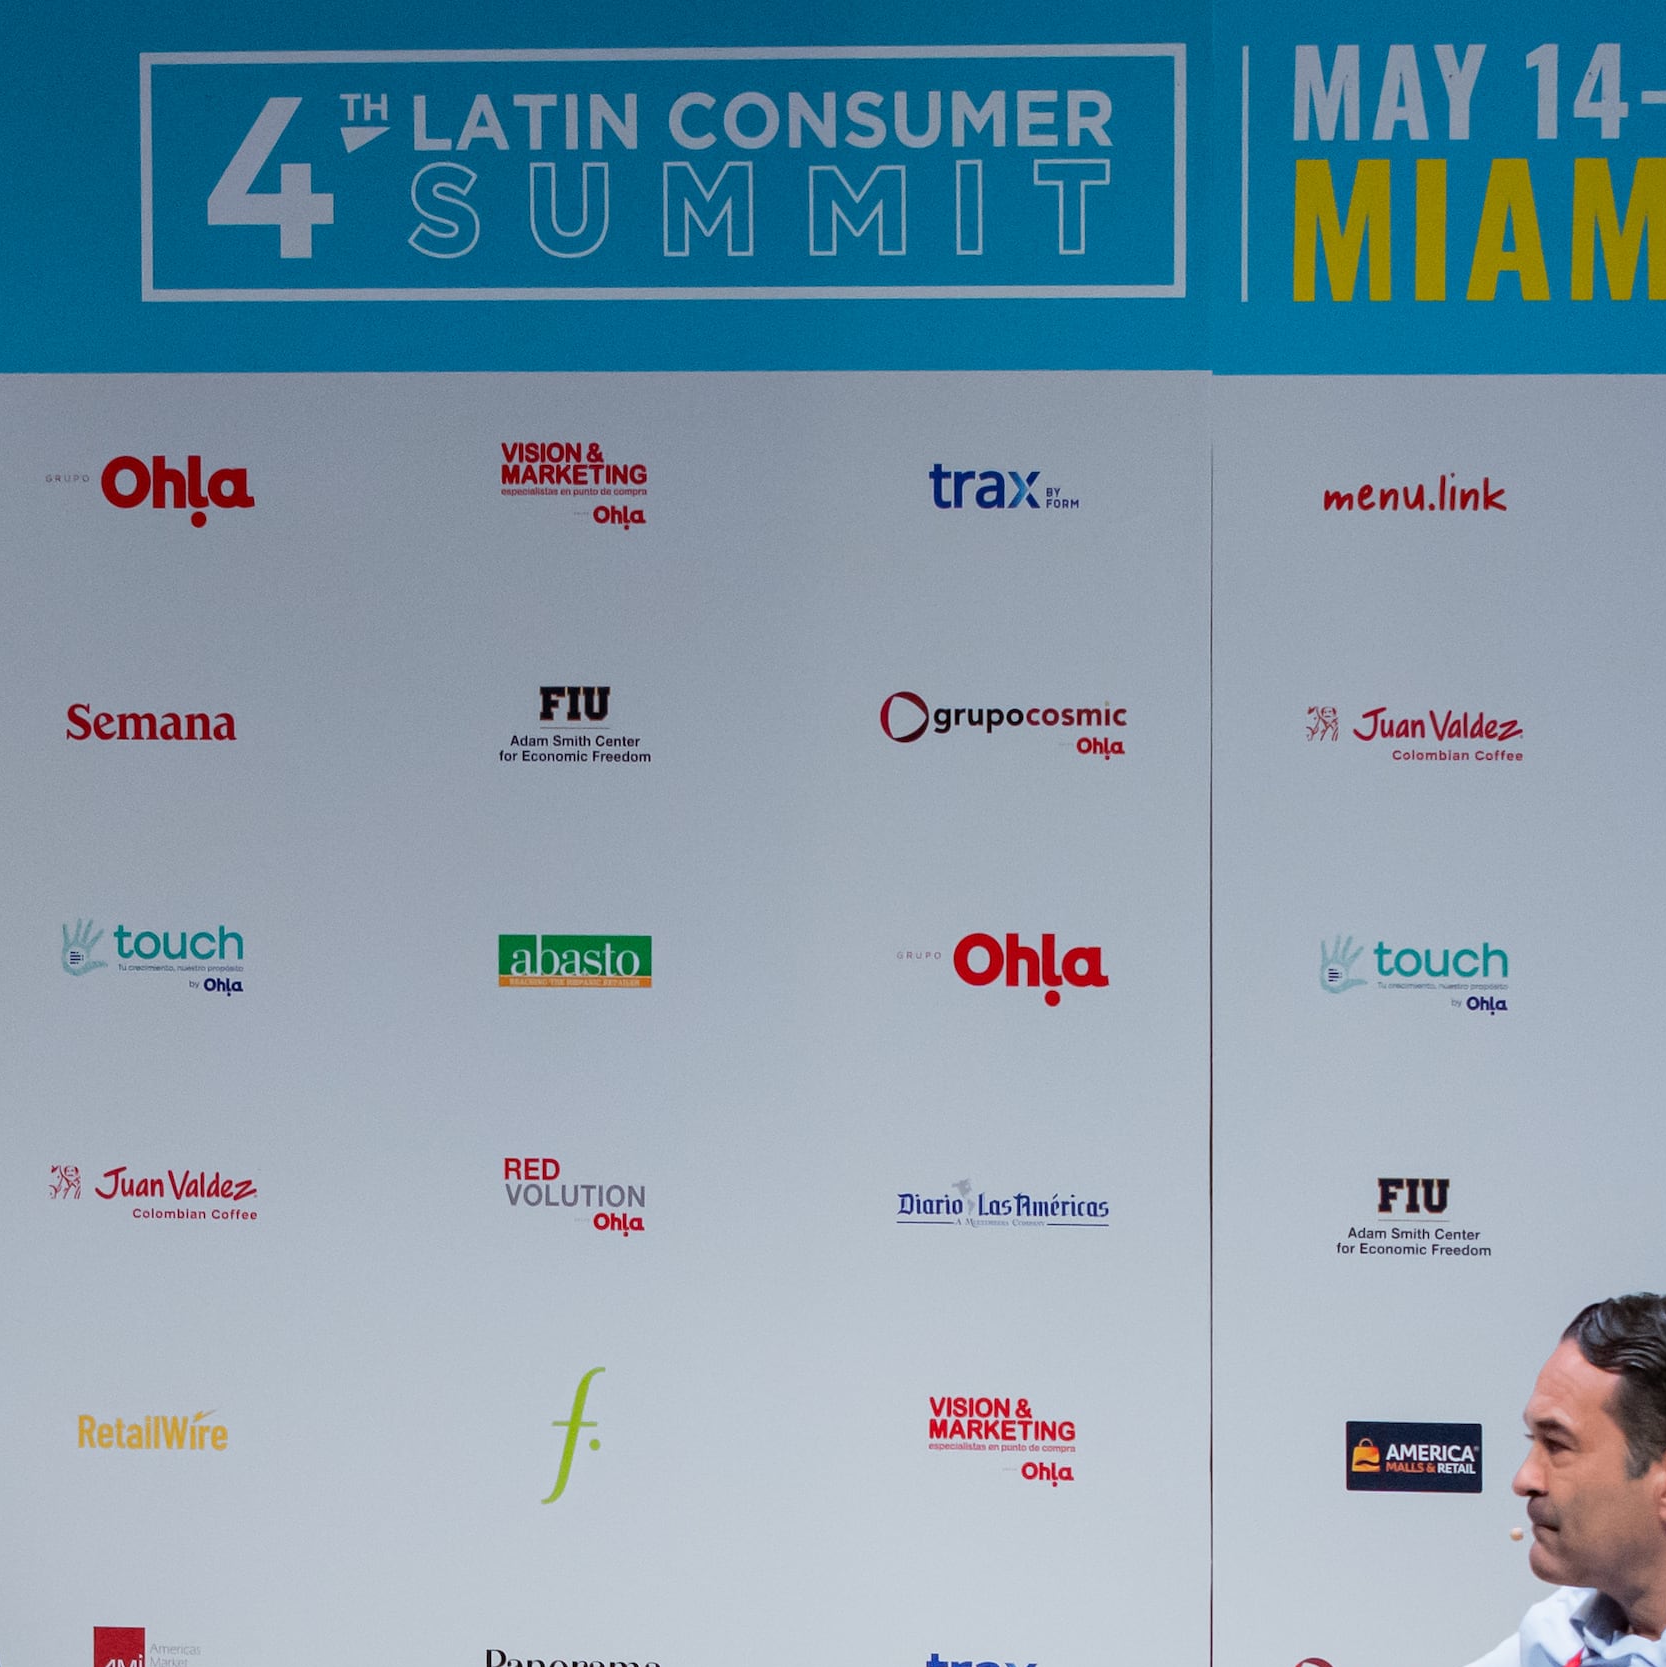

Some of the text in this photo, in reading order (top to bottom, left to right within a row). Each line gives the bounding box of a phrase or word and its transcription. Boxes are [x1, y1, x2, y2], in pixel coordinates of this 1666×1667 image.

[1293, 44, 1487, 141] MAY
[207, 90, 1113, 259] 4 TH LATIN CONSUMER
[408, 158, 1111, 259] SUMMIT
[501, 442, 604, 463] VISION &
[501, 464, 647, 485] MARKETING
[929, 463, 1040, 509] trax
[101, 455, 255, 528] Ohla
[1046, 487, 1060, 499] BY
[1324, 473, 1507, 511] menu.link
[593, 505, 646, 530] Ohla
[540, 686, 610, 721] FIU
[66, 703, 237, 741] Semana
[934, 703, 1126, 734] grupocosmic
[1353, 707, 1523, 742] Juan Valdez
[510, 734, 640, 747] Adam Smith Center
[1076, 738, 1125, 760] Ohla
[499, 750, 651, 762] for Economic Freedom
[1392, 749, 1523, 761] Colombian Coffee
[113, 924, 243, 960] touch
[509, 934, 641, 977] abasto
[1373, 941, 1508, 978] touch
[953, 932, 1109, 1007] Ohla
[203, 978, 243, 997] Ohla
[1466, 996, 1508, 1016] Ohla
[504, 1157, 560, 1181] RED
[95, 1166, 257, 1201] Juan Valdez
[505, 1180, 645, 1208] VOLUTION
[1378, 1178, 1450, 1213] FIU
[132, 1208, 257, 1220] Colombian Coffee
[897, 1192, 1110, 1218] Diario Las Américas
[593, 1212, 645, 1237] Ohla
[1348, 1227, 1480, 1240] Adam Smith Center
[1336, 1242, 1492, 1256] for Economic Freedom
[929, 1396, 1033, 1418] VISION &
[78, 1412, 228, 1451] RetailWire
[929, 1420, 1076, 1440] MARKETING
[1386, 1444, 1475, 1462] AMERICA
[1021, 1461, 1074, 1487] Ohla
[1386, 1462, 1476, 1474] MALLS & RETAIL
[149, 1643, 200, 1655] Americas
